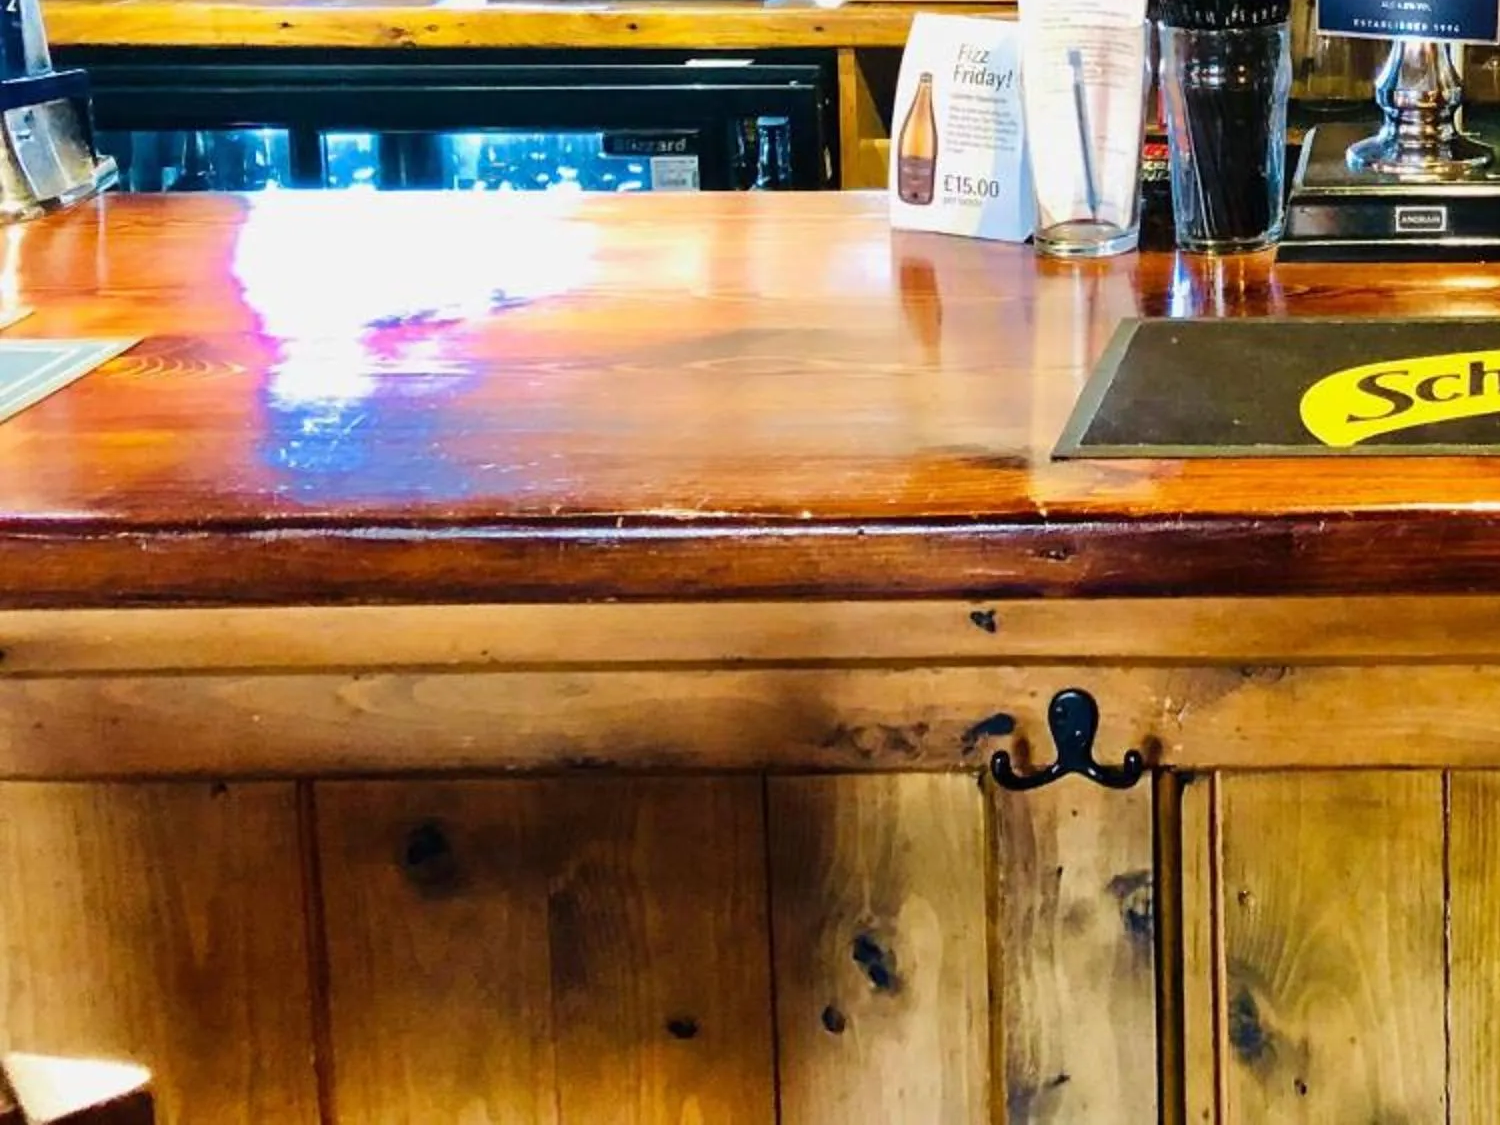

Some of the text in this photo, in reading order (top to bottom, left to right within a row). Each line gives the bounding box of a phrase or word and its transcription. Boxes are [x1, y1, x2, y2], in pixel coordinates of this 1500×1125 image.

[958, 43, 991, 63] Fizz
[953, 64, 1013, 91] Friday!
[943, 174, 1000, 198] £15.00
